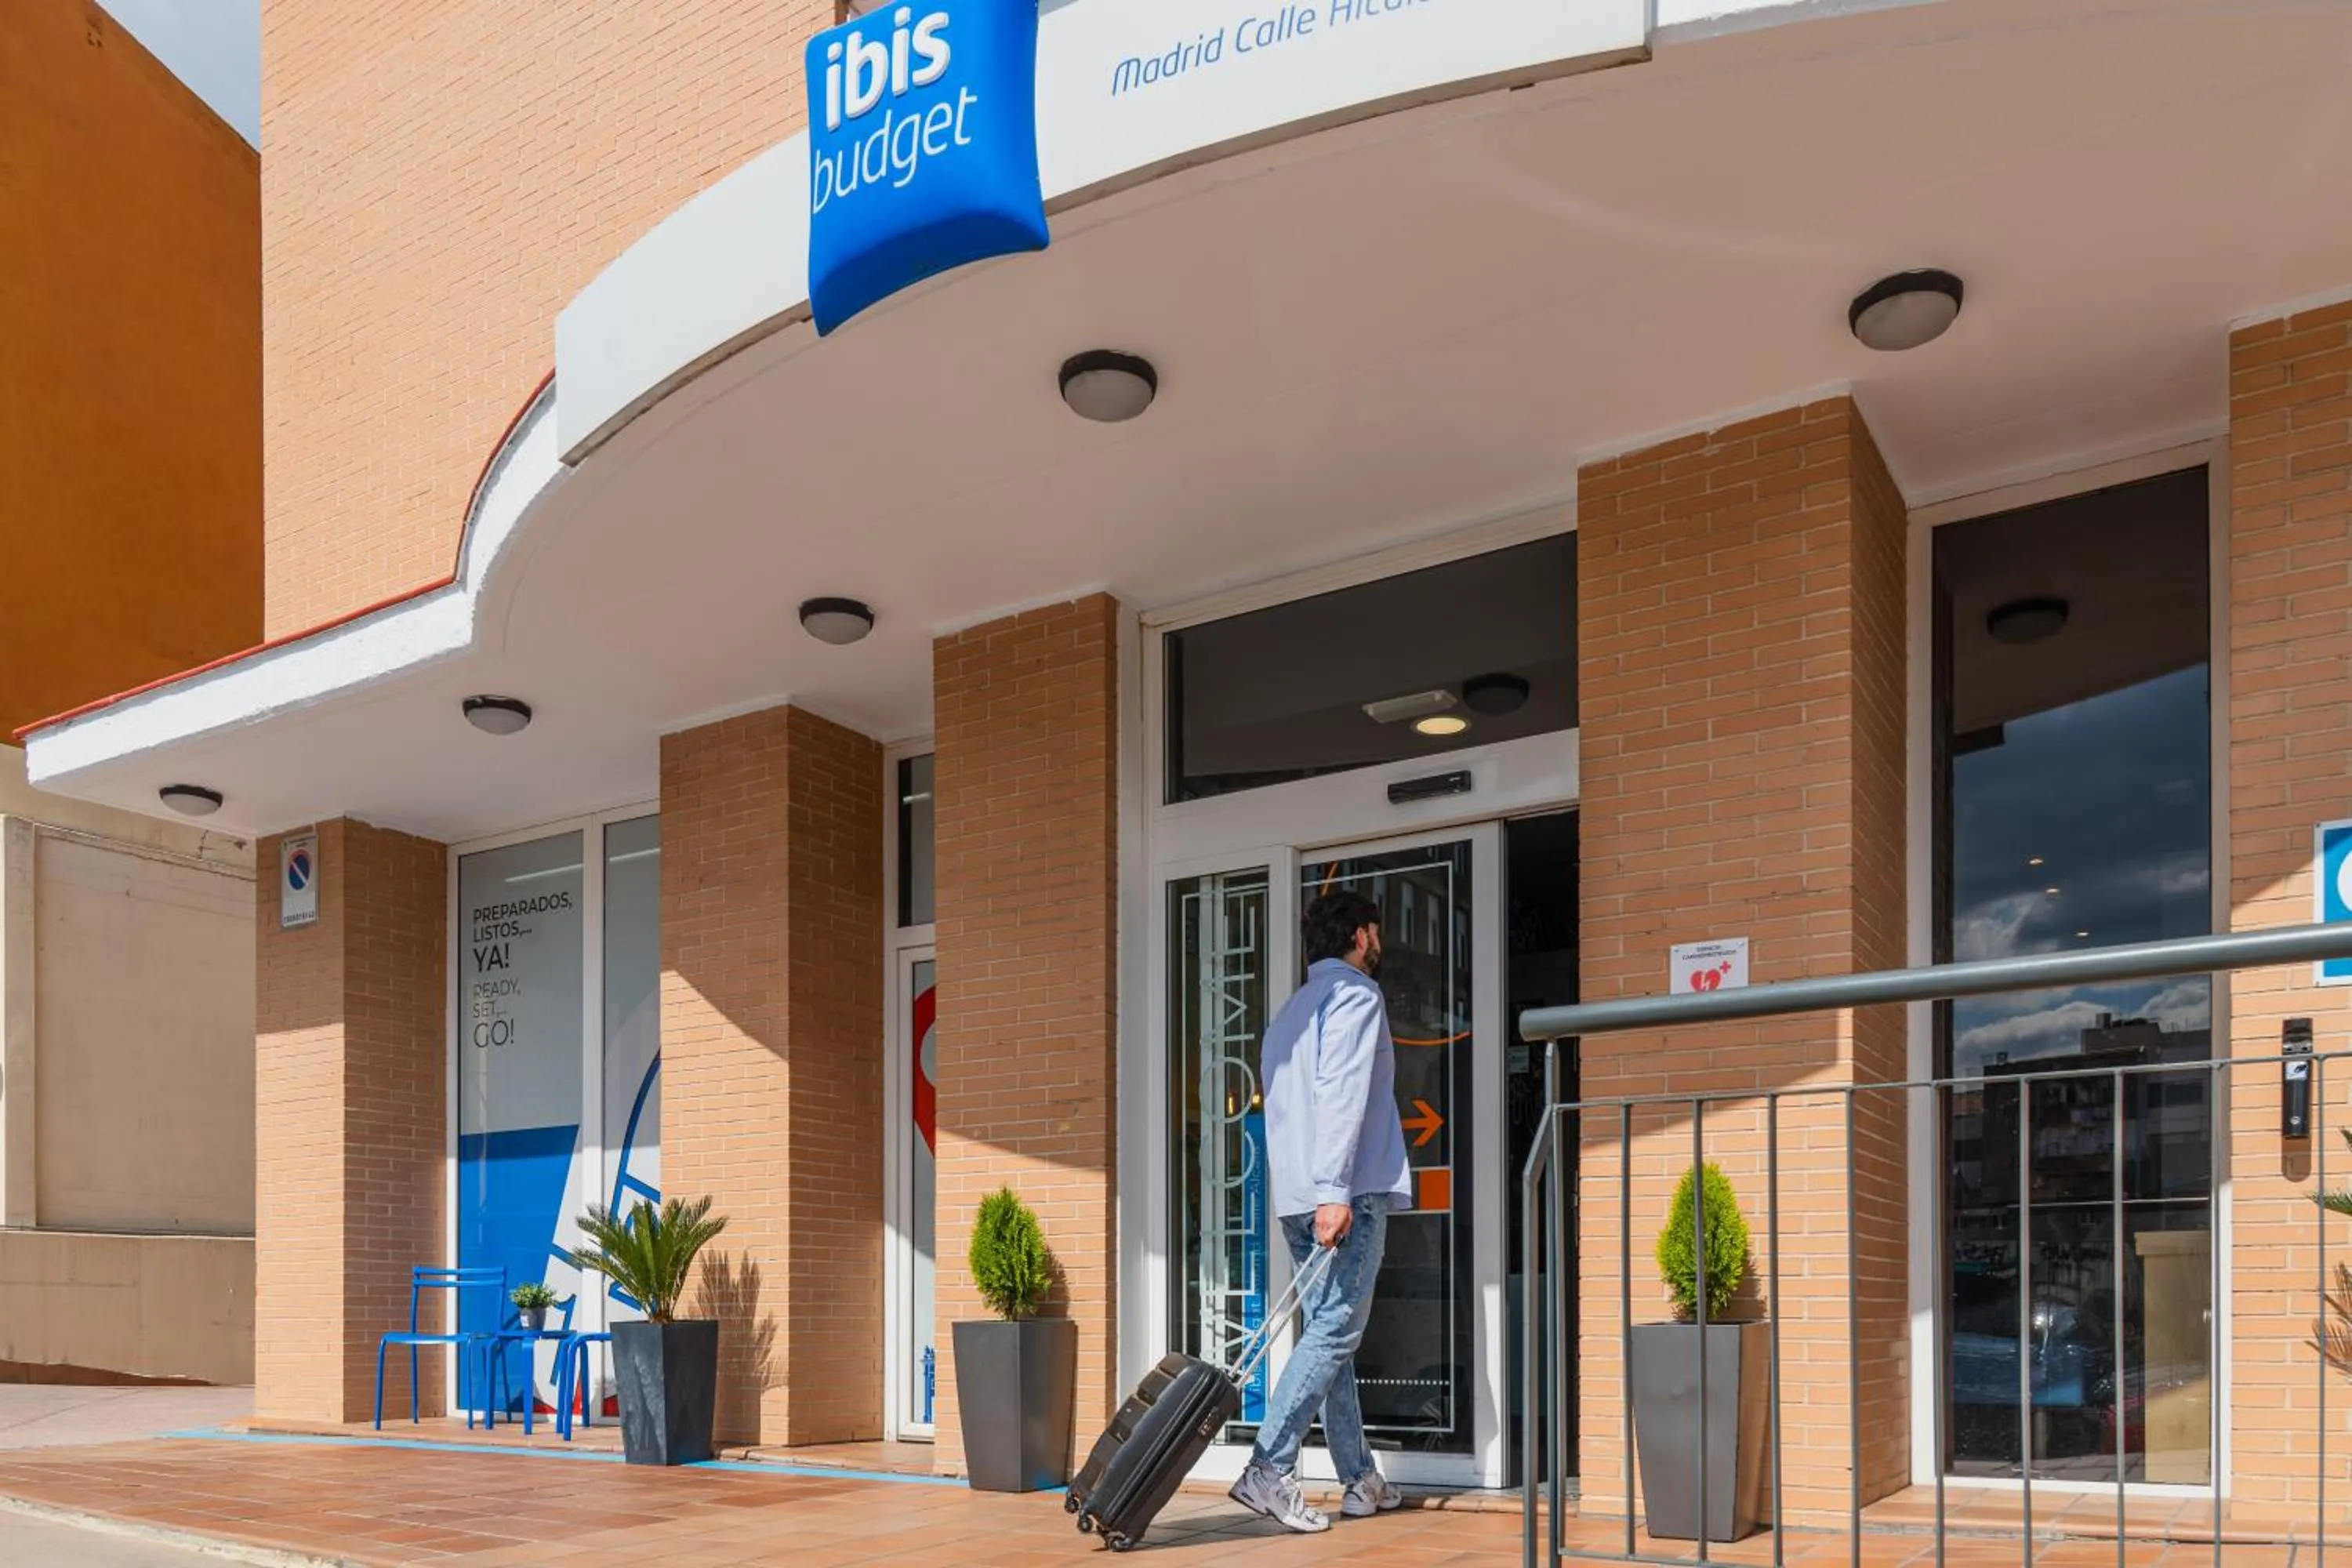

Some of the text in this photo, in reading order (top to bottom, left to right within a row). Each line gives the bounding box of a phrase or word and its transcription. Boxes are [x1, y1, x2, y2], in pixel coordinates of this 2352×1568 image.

[826, 6, 950, 132] ibis
[1111, 0, 1431, 96] Madrid Calle Alc
[813, 86, 978, 214] budget
[473, 891, 573, 924] PREPARADOS,
[473, 942, 510, 973] YA!
[473, 1018, 515, 1048] GO!
[1199, 906, 1258, 1385] WELCOME
